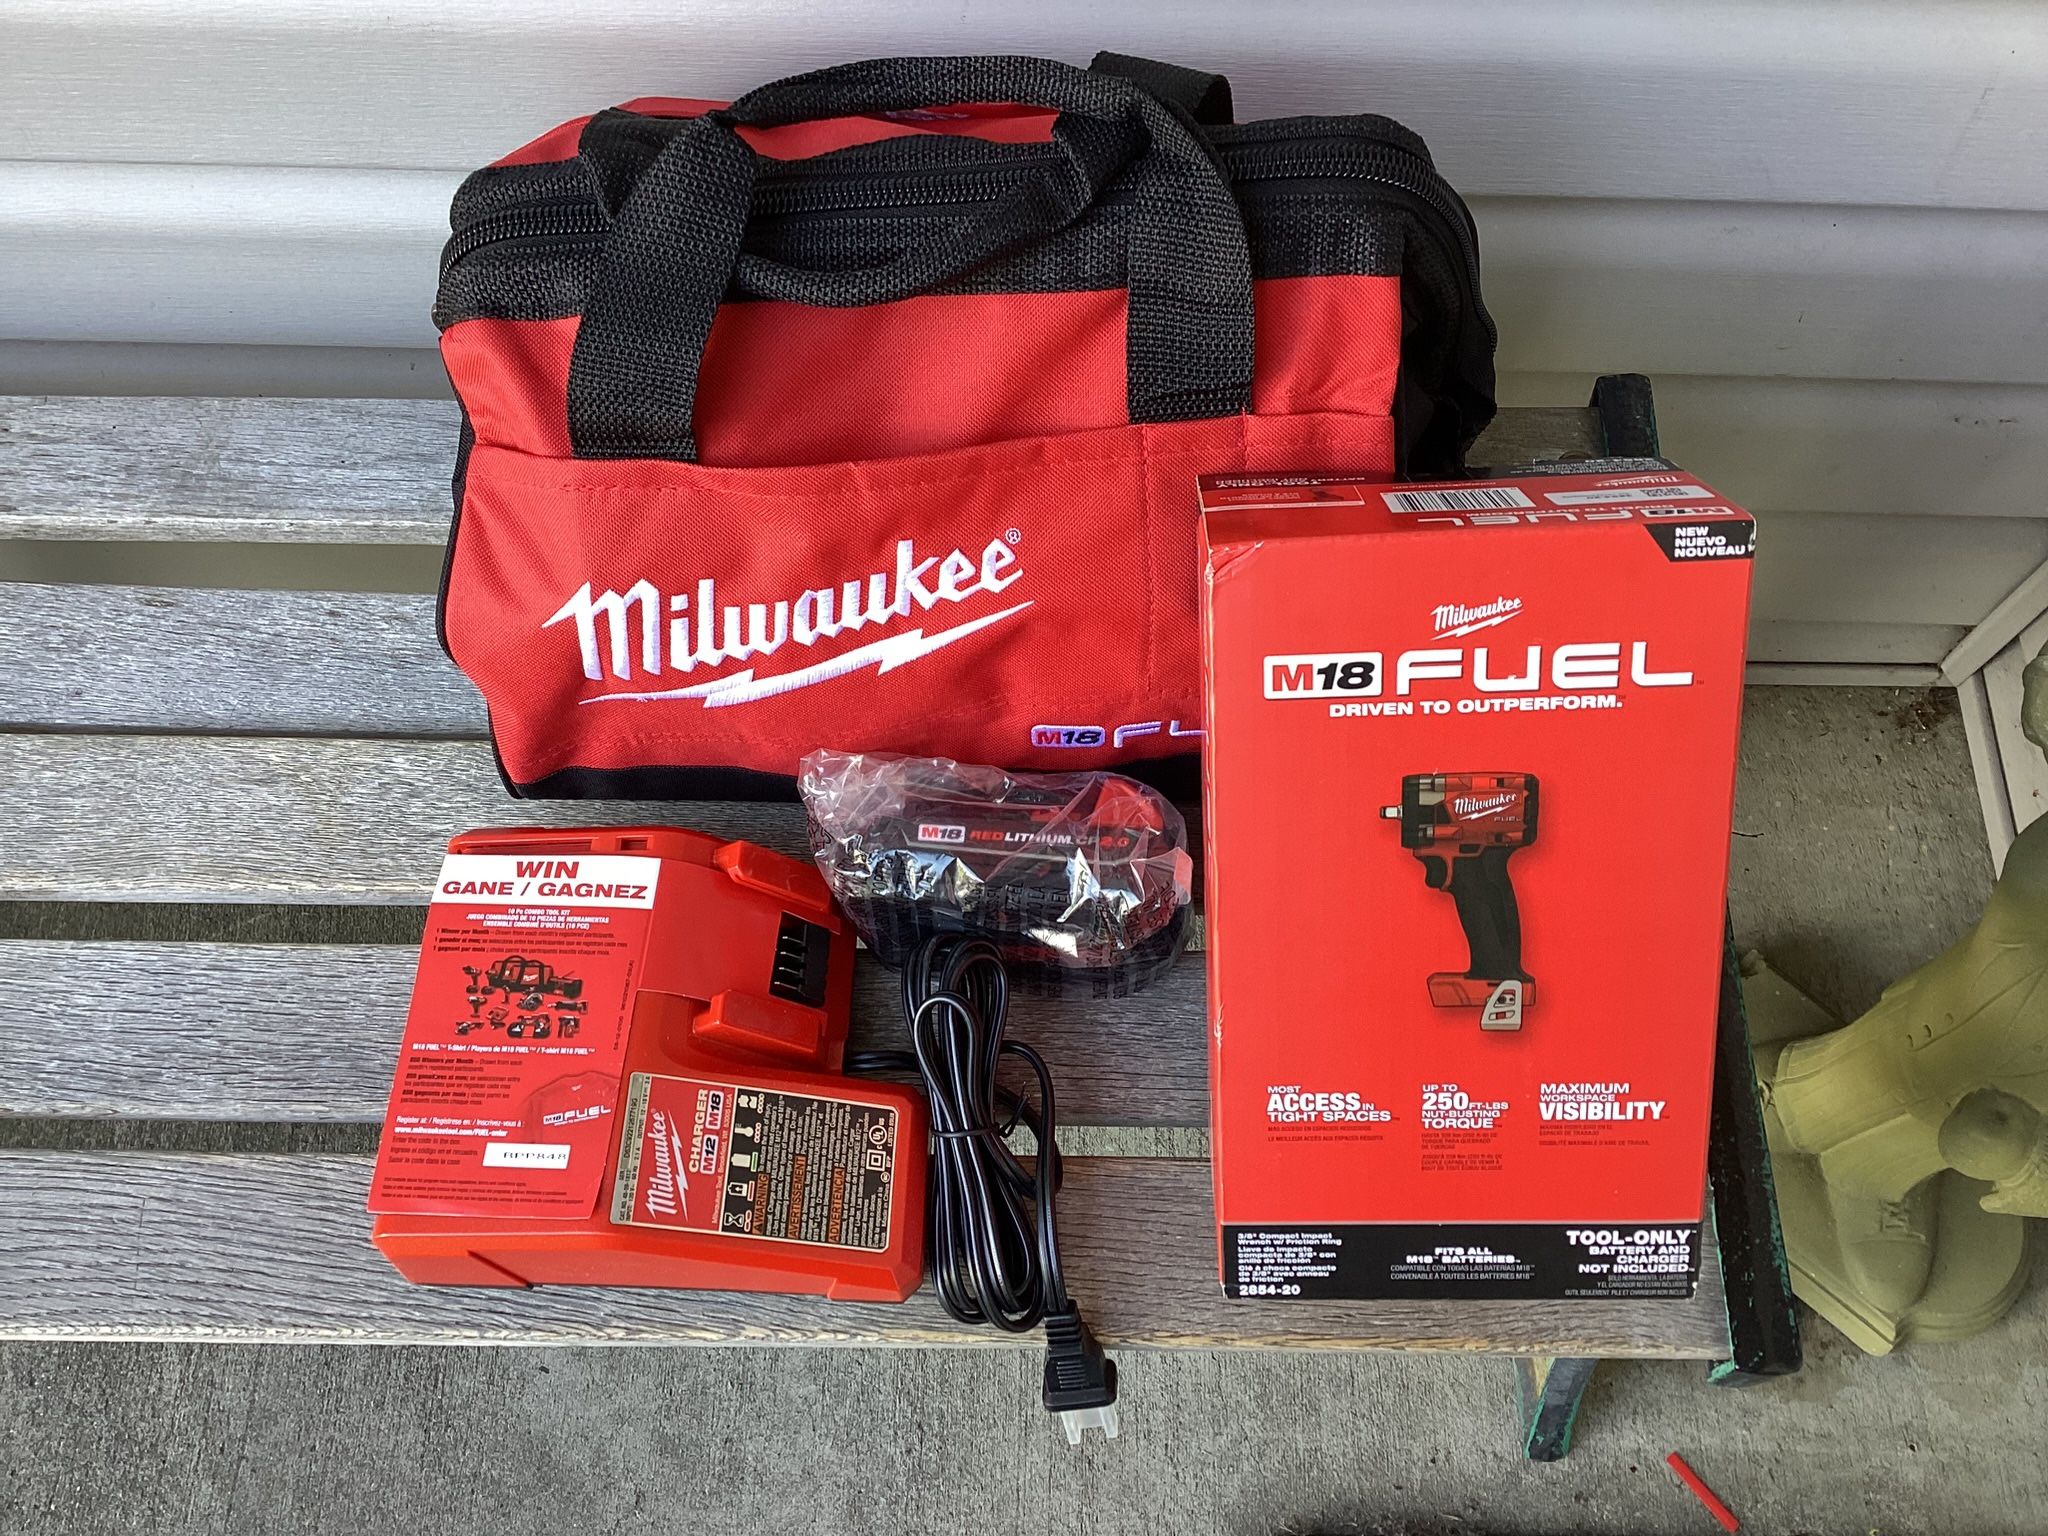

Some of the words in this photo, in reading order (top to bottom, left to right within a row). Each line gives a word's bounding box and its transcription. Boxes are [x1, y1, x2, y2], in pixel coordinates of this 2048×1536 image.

[1417, 508, 1633, 526] FUEL
[1675, 526, 1709, 537] NEW
[1675, 536, 1727, 547] NUEVO
[1674, 545, 1746, 558] NOUVEAU
[541, 538, 1024, 682] Milwaukee
[1430, 596, 1523, 632] Milwaukee
[1269, 658, 1377, 694] M18
[1396, 641, 1693, 696] FUEL
[1329, 701, 1414, 718] DRIVEN
[1420, 700, 1452, 716] TO
[1457, 695, 1623, 715] OUTPERFORM.
[1033, 728, 1103, 746] M18
[1454, 793, 1517, 814] Milwaukee
[920, 825, 963, 841] M18
[515, 861, 580, 879] WIN
[442, 881, 514, 895] GANE
[520, 881, 530, 896] /
[537, 883, 648, 899] GAGNEZ
[513, 920, 539, 928] COMBINÉ
[1267, 1085, 1301, 1094] MOST
[1422, 1084, 1439, 1092] UP
[1441, 1084, 1458, 1092] TO
[1540, 1082, 1630, 1094] MAXIMUM
[1267, 1092, 1361, 1111] ACCESS
[1362, 1103, 1375, 1111] IN
[1422, 1091, 1469, 1110] 250
[1469, 1102, 1509, 1110] FT-LBS
[1540, 1094, 1615, 1102] WORKSPACE
[564, 1105, 612, 1121] FUEL
[708, 1093, 721, 1127] M18
[1267, 1111, 1318, 1122] TIGHT
[1322, 1110, 1391, 1122] SPACES
[1421, 1110, 1500, 1118] NUT-BUSTING
[1539, 1101, 1666, 1120] VISIBILITY
[689, 1088, 708, 1173] CHARGER
[1422, 1118, 1494, 1129] TORQUE
[702, 1136, 716, 1172] M12
[771, 1143, 780, 1178] MILWAUKEE
[645, 1110, 678, 1219] Milwaukee
[777, 1166, 785, 1180] Other
[754, 1175, 767, 1223] WARNING
[767, 1192, 776, 1213] Charge
[788, 1156, 805, 1237] AVERTISSEMENT
[712, 1190, 721, 1224] Milwaukee
[774, 1200, 782, 1220] battery
[829, 1168, 844, 1242] ADVERTENCIA
[1259, 1232, 1300, 1240] Compact
[1301, 1232, 1332, 1240] Impact
[1566, 1230, 1691, 1245] TOOL-ONLY
[1434, 1247, 1465, 1255] FITS
[1467, 1247, 1493, 1255] ALL
[1589, 1246, 1655, 1255] BATTERY
[1658, 1245, 1690, 1254] AND
[1406, 1255, 1433, 1264] M18
[1616, 1255, 1690, 1264] CHARGER
[1390, 1264, 1431, 1272] COMPATIBLE
[1431, 1264, 1446, 1272] CON
[1448, 1264, 1468, 1272] TODAS
[1470, 1264, 1483, 1272] LAS
[1390, 1272, 1433, 1280] CONVENABLE
[1440, 1272, 1465, 1280] TOUTES
[1467, 1272, 1479, 1280] LES
[1480, 1272, 1515, 1280] BATTERIES
[1578, 1264, 1610, 1273] NOT
[1613, 1264, 1689, 1273] INCLUDED
[1239, 1284, 1301, 1295] 2854-20
